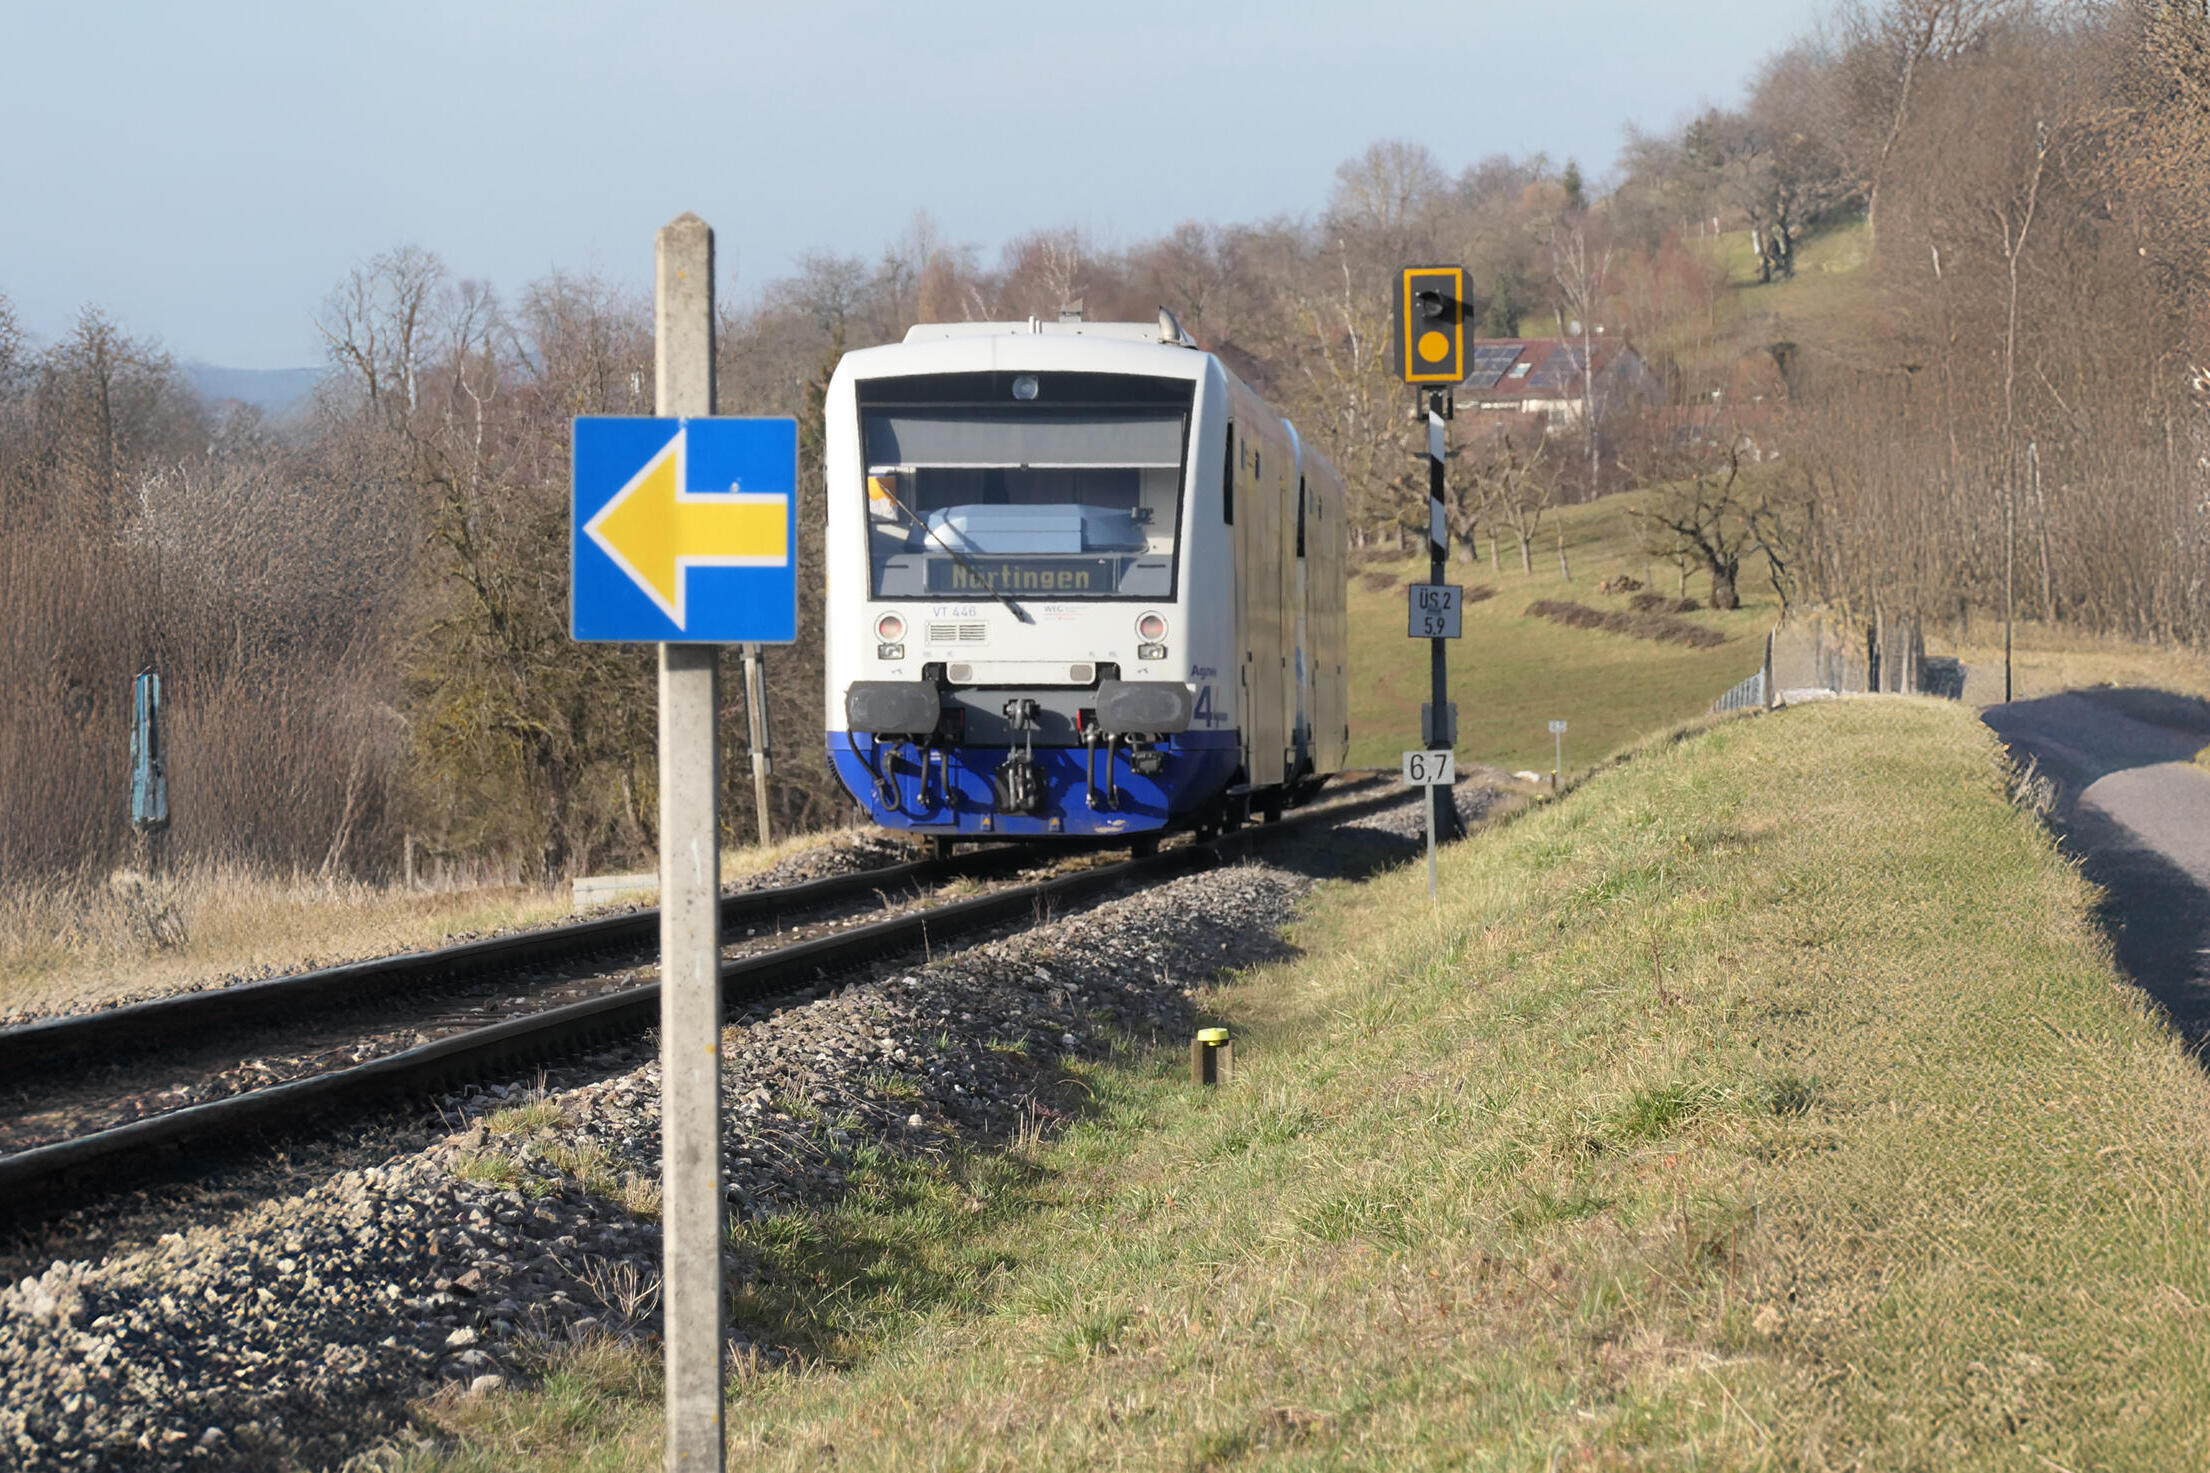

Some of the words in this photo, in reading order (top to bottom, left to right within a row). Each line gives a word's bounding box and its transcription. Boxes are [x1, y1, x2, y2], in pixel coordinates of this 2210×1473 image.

[1419, 587, 1439, 610] ÜS
[1443, 591, 1451, 610] 2
[933, 605, 948, 617] VT
[1410, 754, 1447, 783] 6,7
